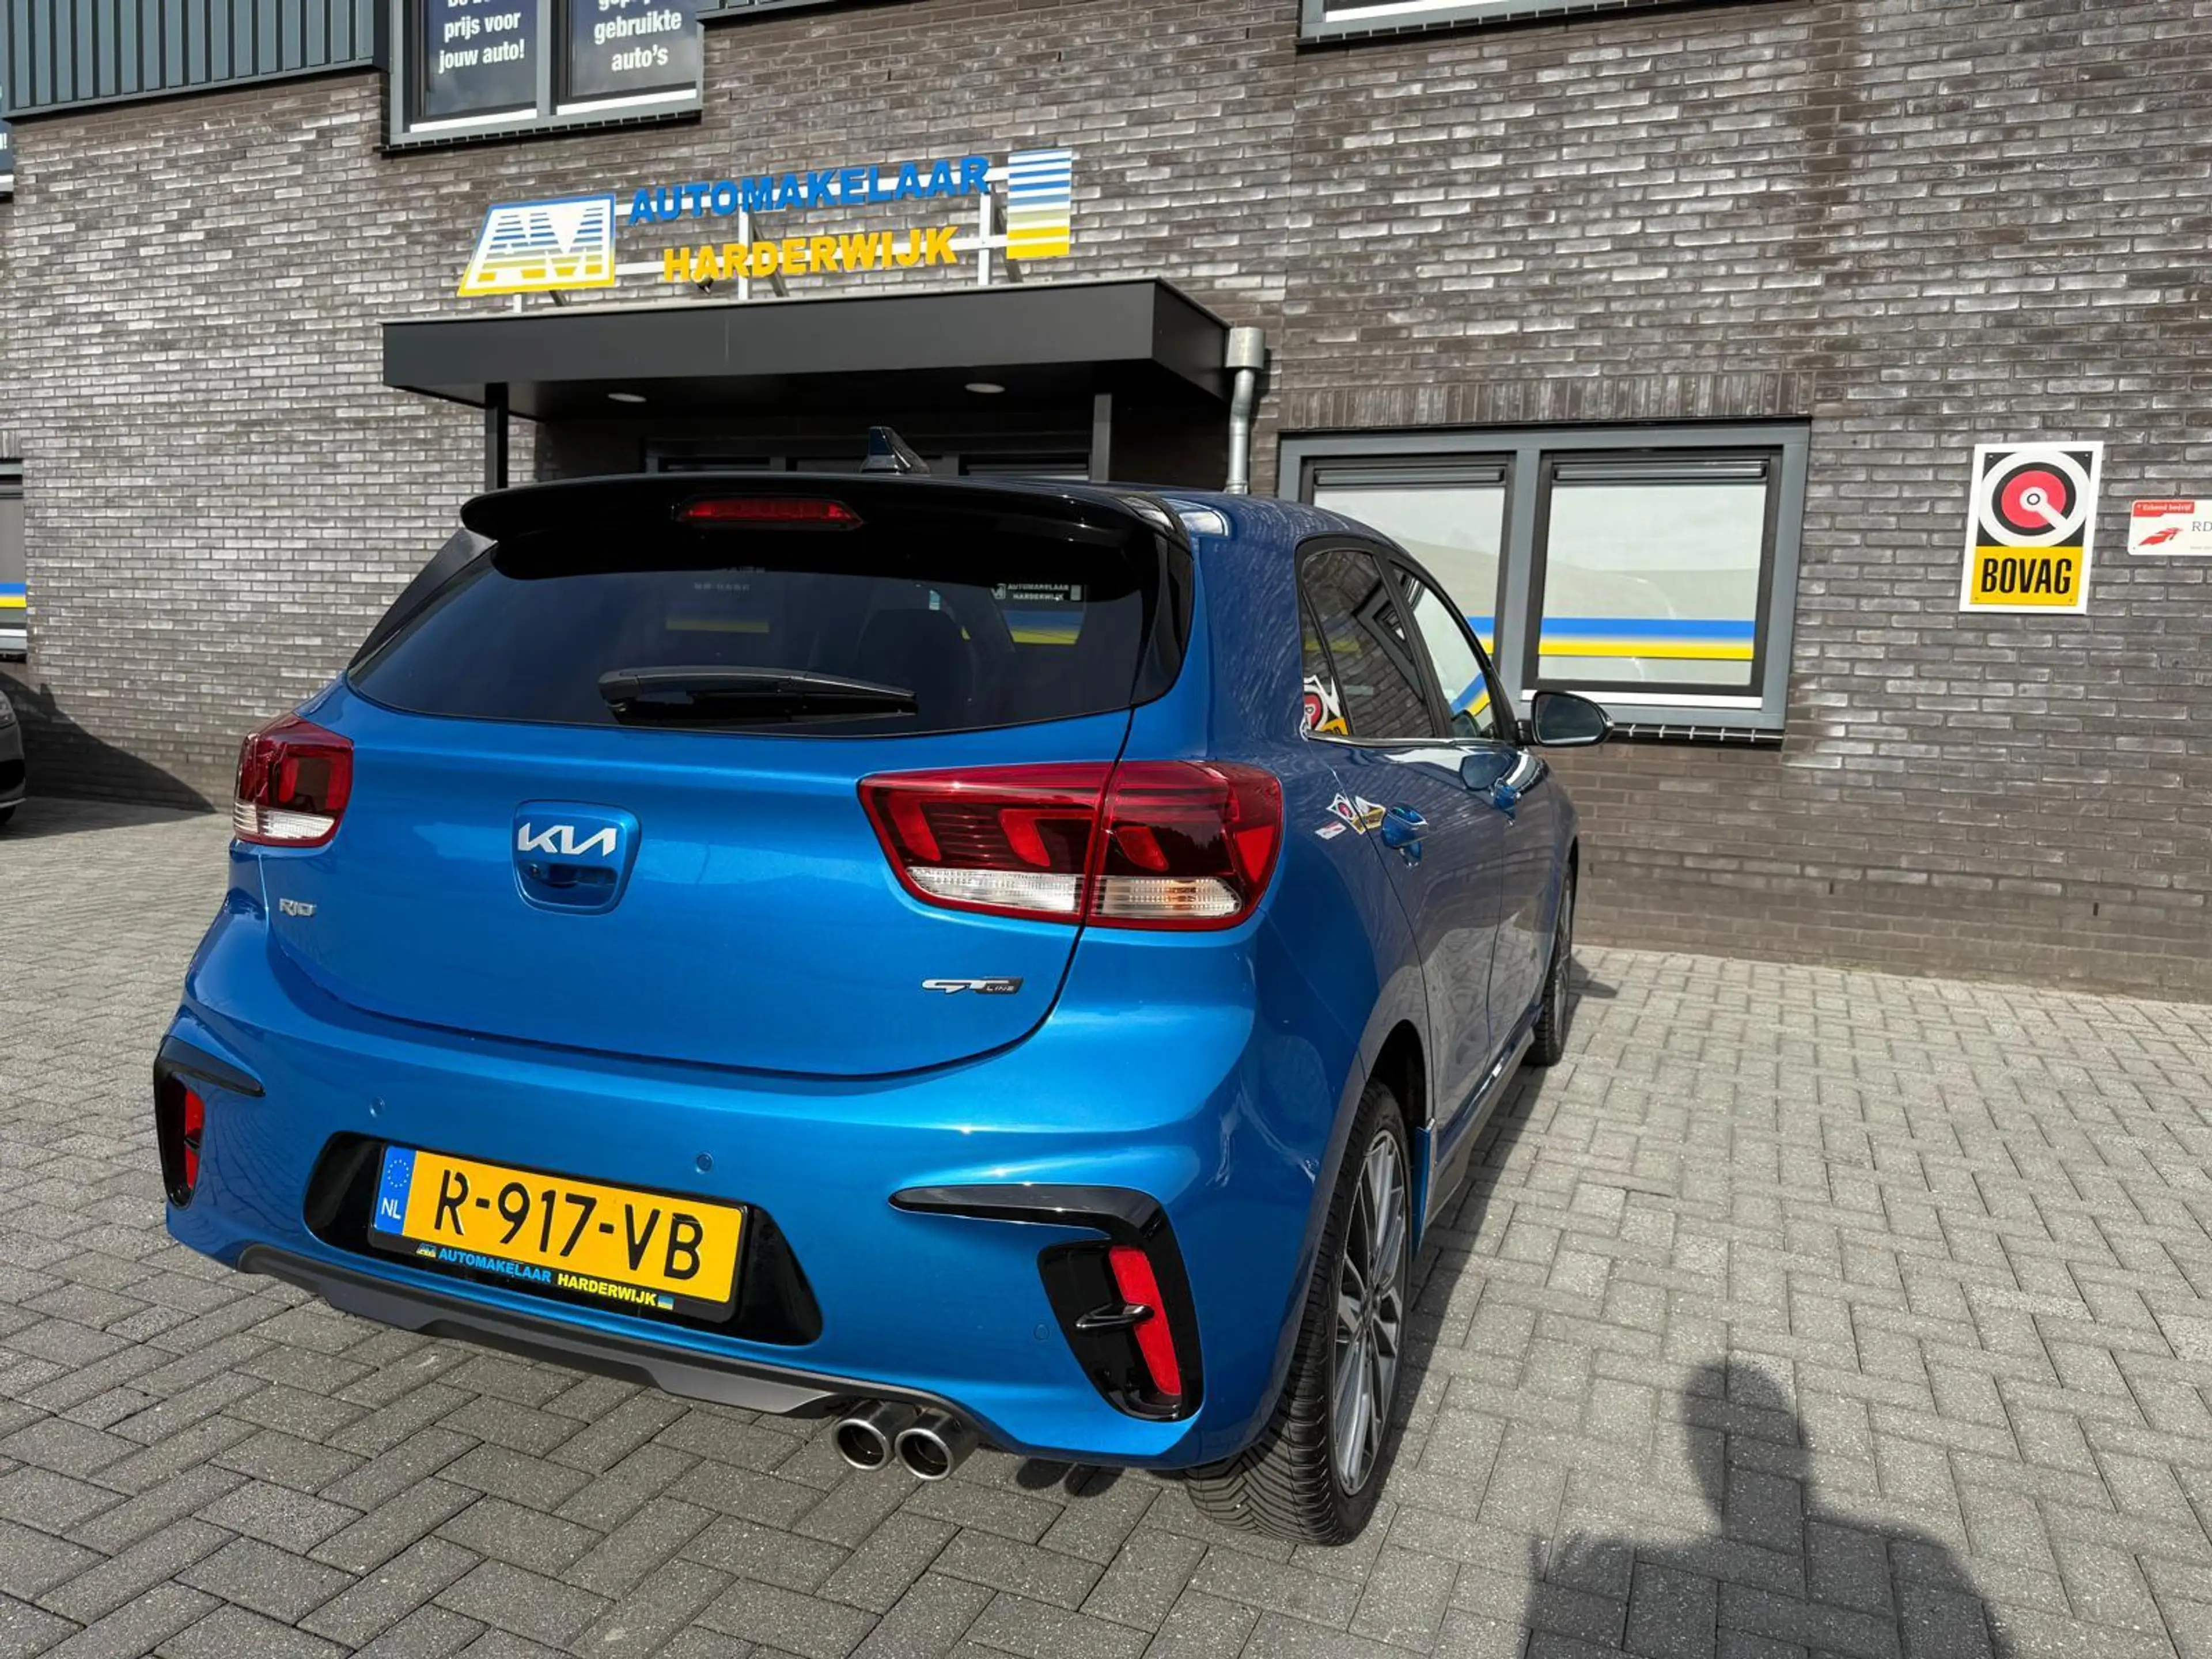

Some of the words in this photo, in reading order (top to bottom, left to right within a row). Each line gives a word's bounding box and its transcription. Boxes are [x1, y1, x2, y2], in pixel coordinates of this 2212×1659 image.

[444, 15, 480, 43] prijs
[484, 12, 521, 32] voor
[594, 9, 682, 45] gebruikte
[438, 50, 479, 74] jouw
[483, 39, 525, 63] auto!
[611, 44, 668, 71] auto's
[628, 156, 991, 227] AUTOMAKELAAR
[663, 226, 959, 283] HARDERWIJK
[1980, 557, 2073, 594] BOVAG
[381, 1196, 402, 1220] NL
[434, 1169, 704, 1281] R-917-VB
[438, 1247, 552, 1283] AUTOMAKELAAR
[557, 1272, 657, 1306] HARDERWIJK
